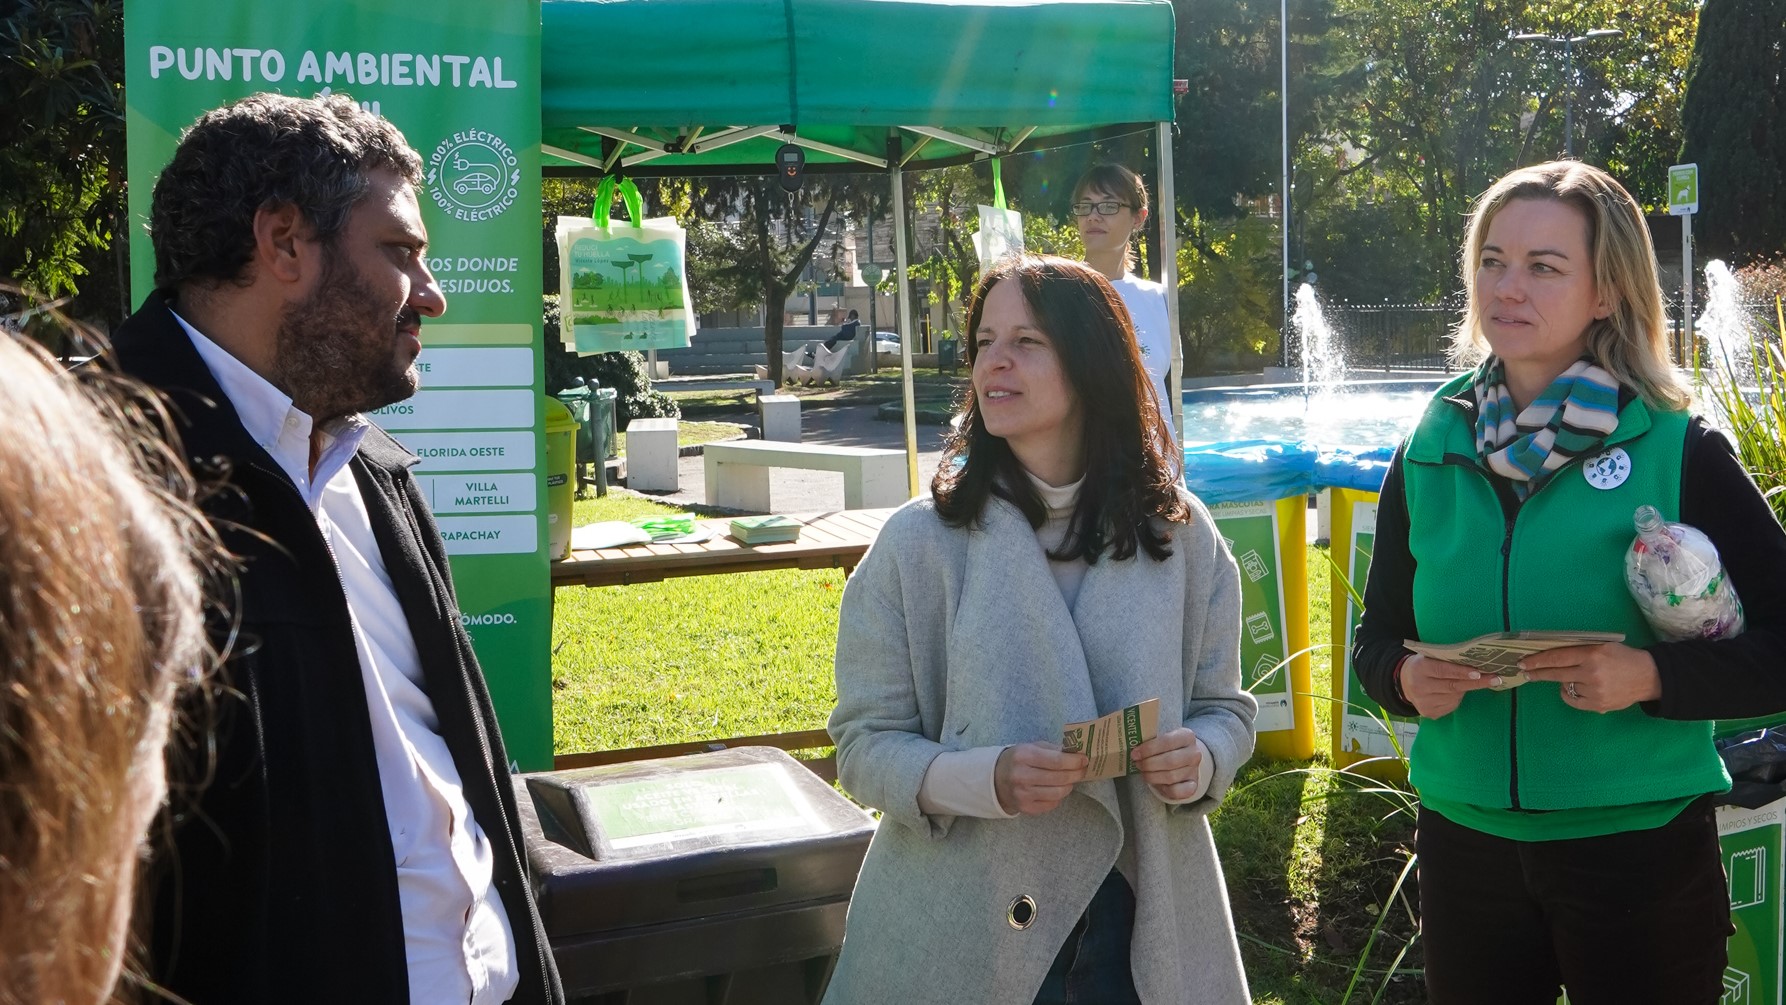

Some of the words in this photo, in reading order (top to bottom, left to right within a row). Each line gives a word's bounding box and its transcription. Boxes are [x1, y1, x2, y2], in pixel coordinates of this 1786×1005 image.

[149, 46, 286, 82] PUNTO
[297, 50, 518, 89] AMBIENTAL
[430, 139, 454, 166] 100%
[453, 127, 518, 167] ELÉCTRICO
[430, 187, 455, 215] 100%
[455, 188, 518, 222] ELÉCTRICO
[457, 257, 519, 272] DONDE
[417, 448, 467, 458] FLORIDA
[469, 447, 505, 457] OESTE
[465, 482, 498, 492] VILLA
[454, 495, 509, 506] MARTELLI
[1221, 500, 1264, 509] MASCOTAS
[1127, 707, 1138, 735] VICENTE
[1753, 811, 1778, 824] SECOS
